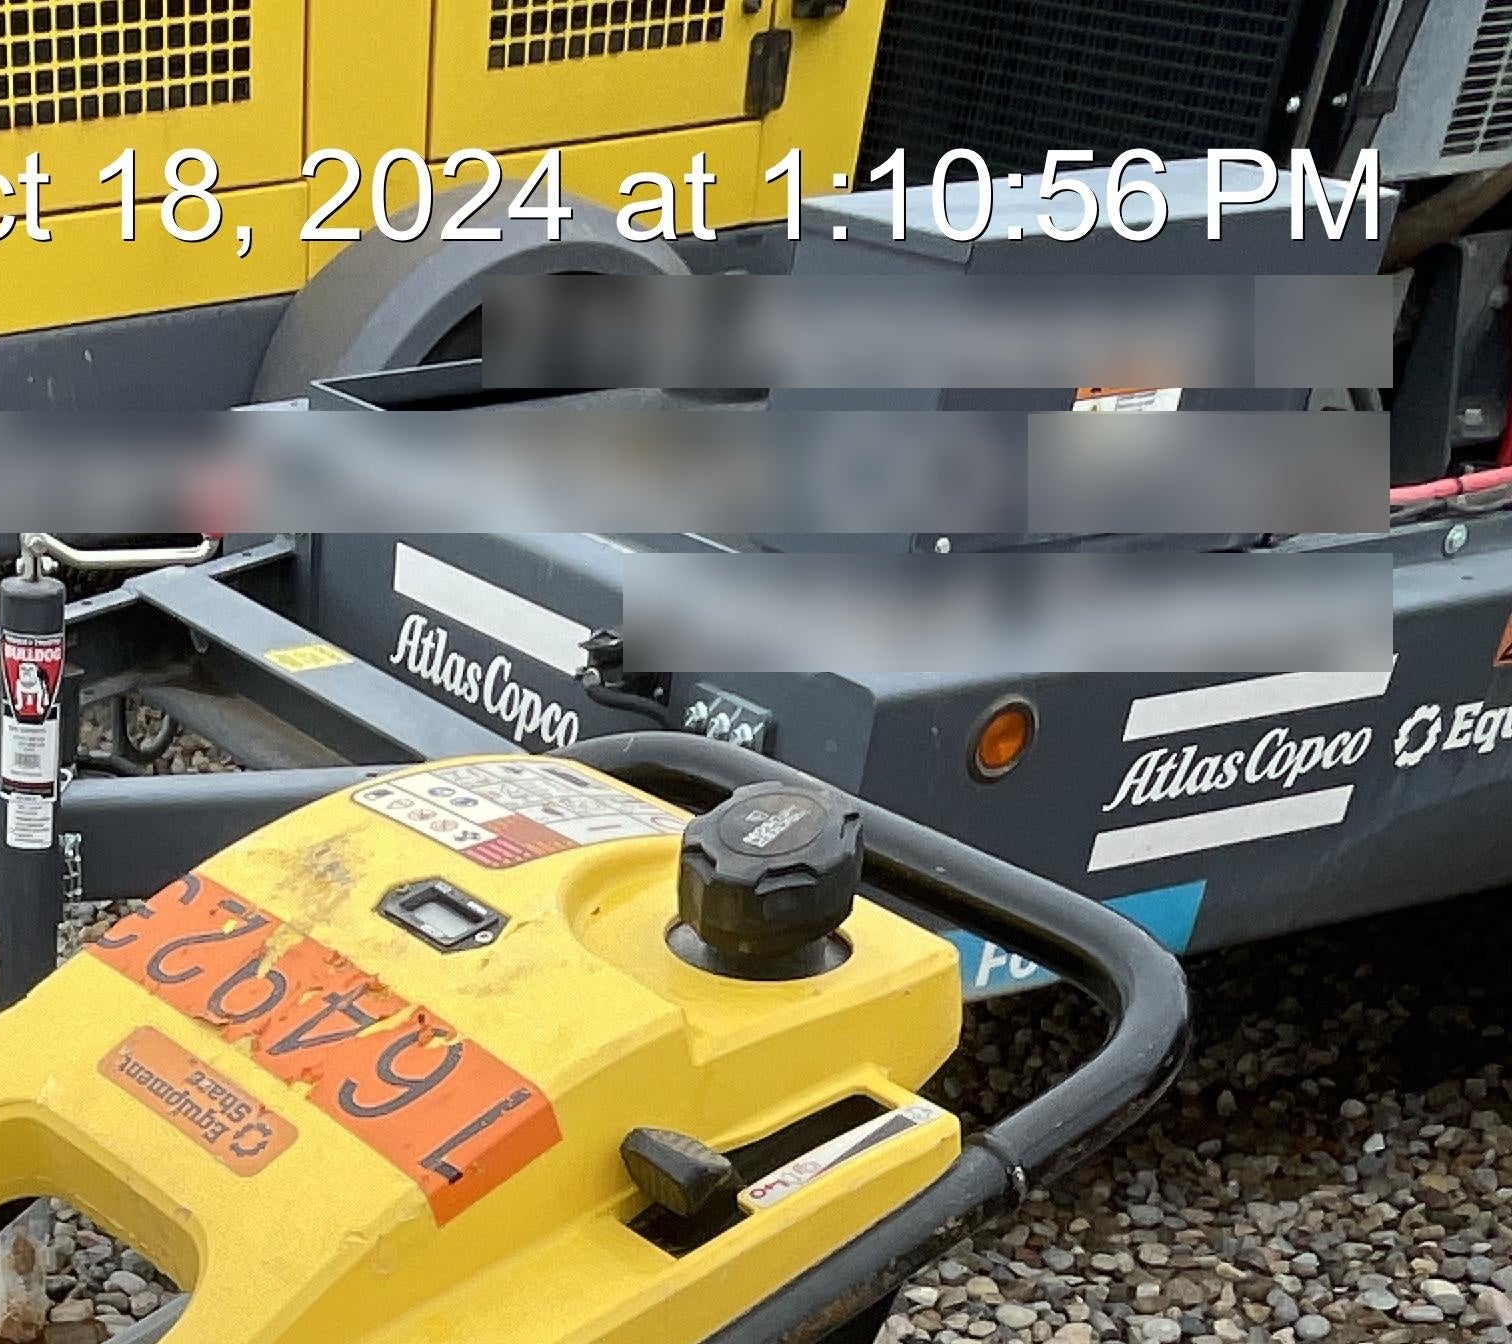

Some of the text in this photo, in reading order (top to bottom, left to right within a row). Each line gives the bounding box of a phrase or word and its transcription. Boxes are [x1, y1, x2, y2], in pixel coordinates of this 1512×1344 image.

[390, 614, 580, 749] Atlas Copco
[1102, 727, 1373, 812] Atlas Copco
[116, 1050, 231, 1147] Equipment
[185, 1069, 252, 1128] Share
